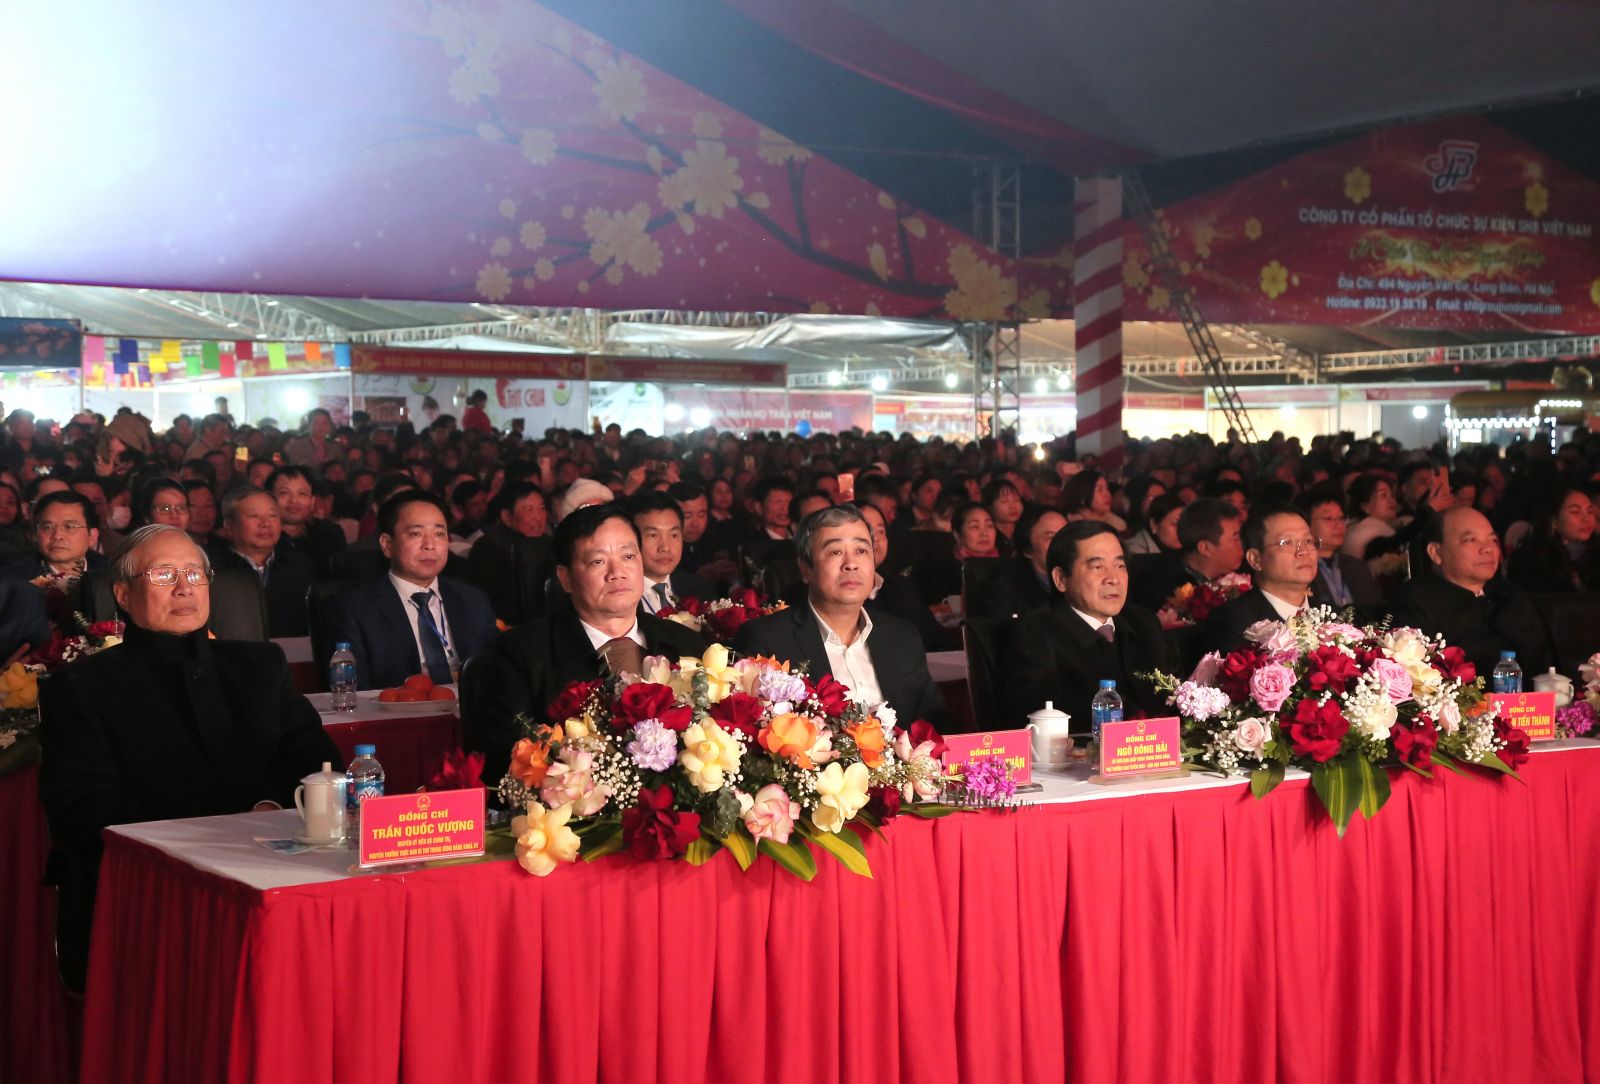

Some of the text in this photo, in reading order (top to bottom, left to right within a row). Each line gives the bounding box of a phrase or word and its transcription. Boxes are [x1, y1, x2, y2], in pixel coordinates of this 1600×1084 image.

[1299, 205, 1338, 223] CÔNG
[1342, 209, 1355, 223] TY
[524, 387, 546, 408] CHUA
[1146, 733, 1157, 741] CHÍ
[992, 746, 1005, 755] CHÍ
[1117, 740, 1168, 757] NGÔ ĐÔNG HẢI
[398, 808, 449, 822] ĐỒNG CHÍ
[372, 820, 474, 840] TRẦN QUỐC VƯỢNG
